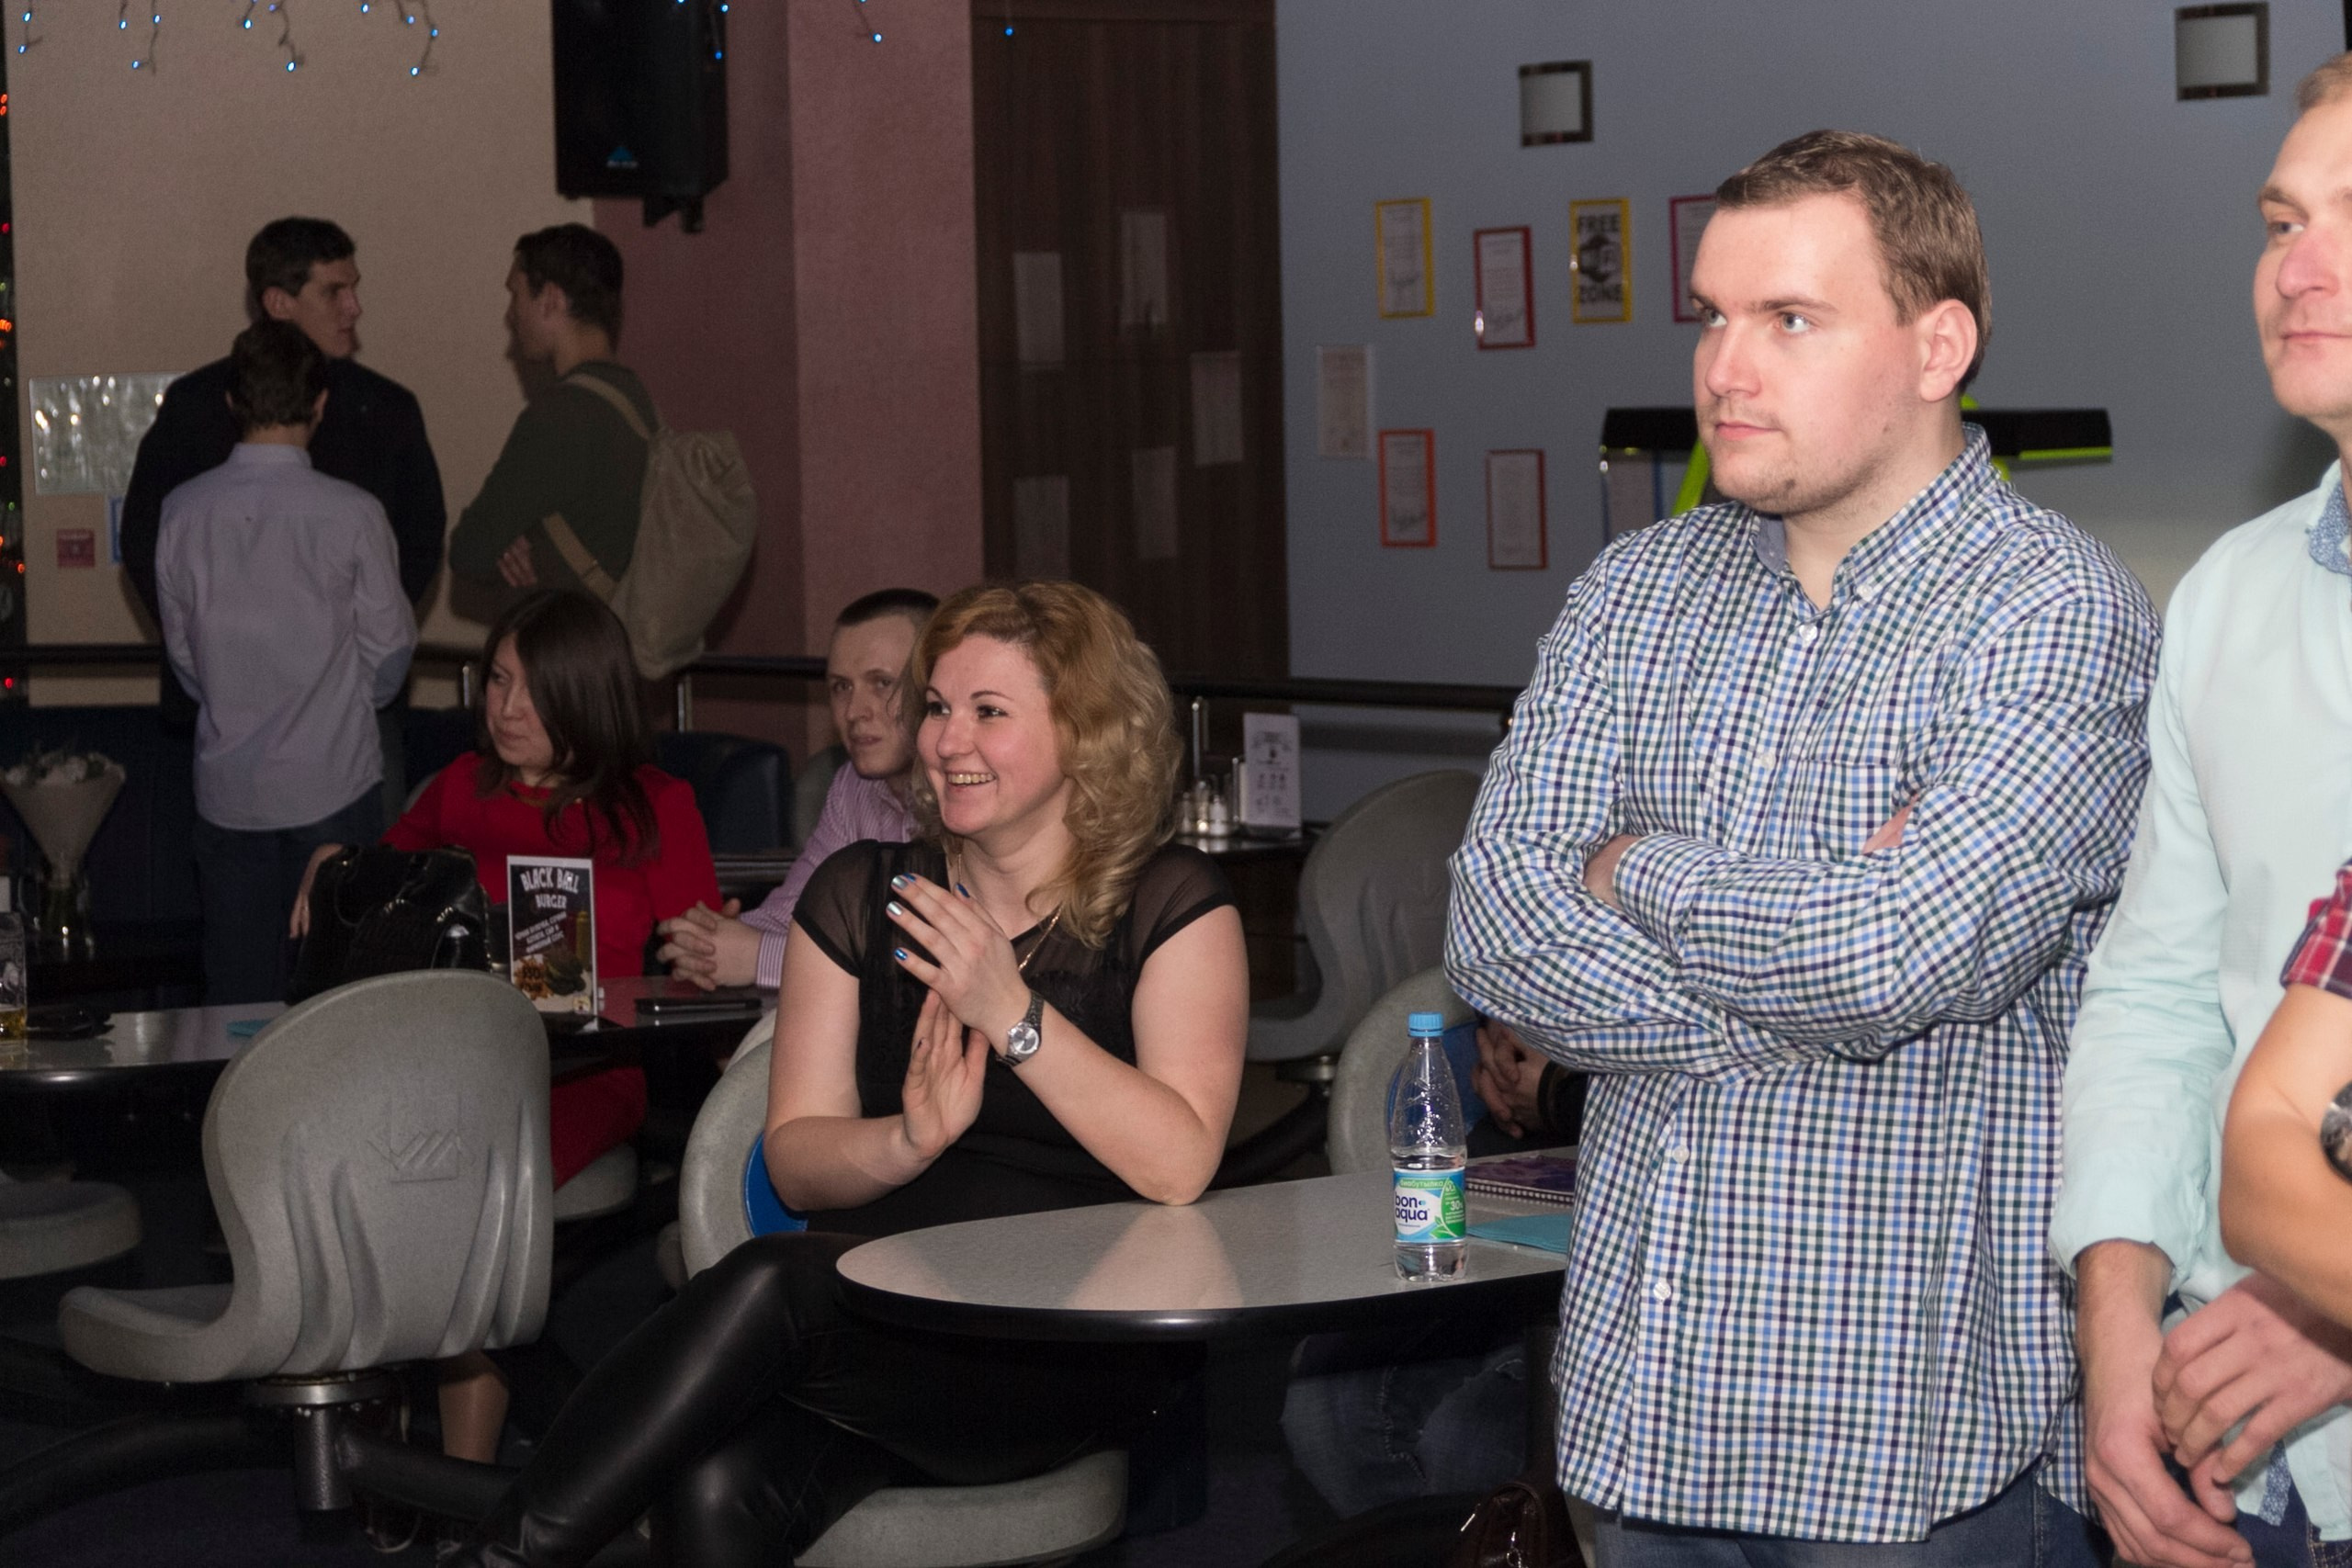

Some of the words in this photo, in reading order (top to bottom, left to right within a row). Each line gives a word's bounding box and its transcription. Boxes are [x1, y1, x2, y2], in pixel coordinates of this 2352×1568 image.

[1577, 214, 1619, 233] FREE
[1578, 283, 1623, 303] ZONE
[520, 867, 553, 892] BLACK
[556, 869, 580, 894] BALL
[535, 894, 567, 908] BURGER
[1396, 1208, 1428, 1223] aqua
